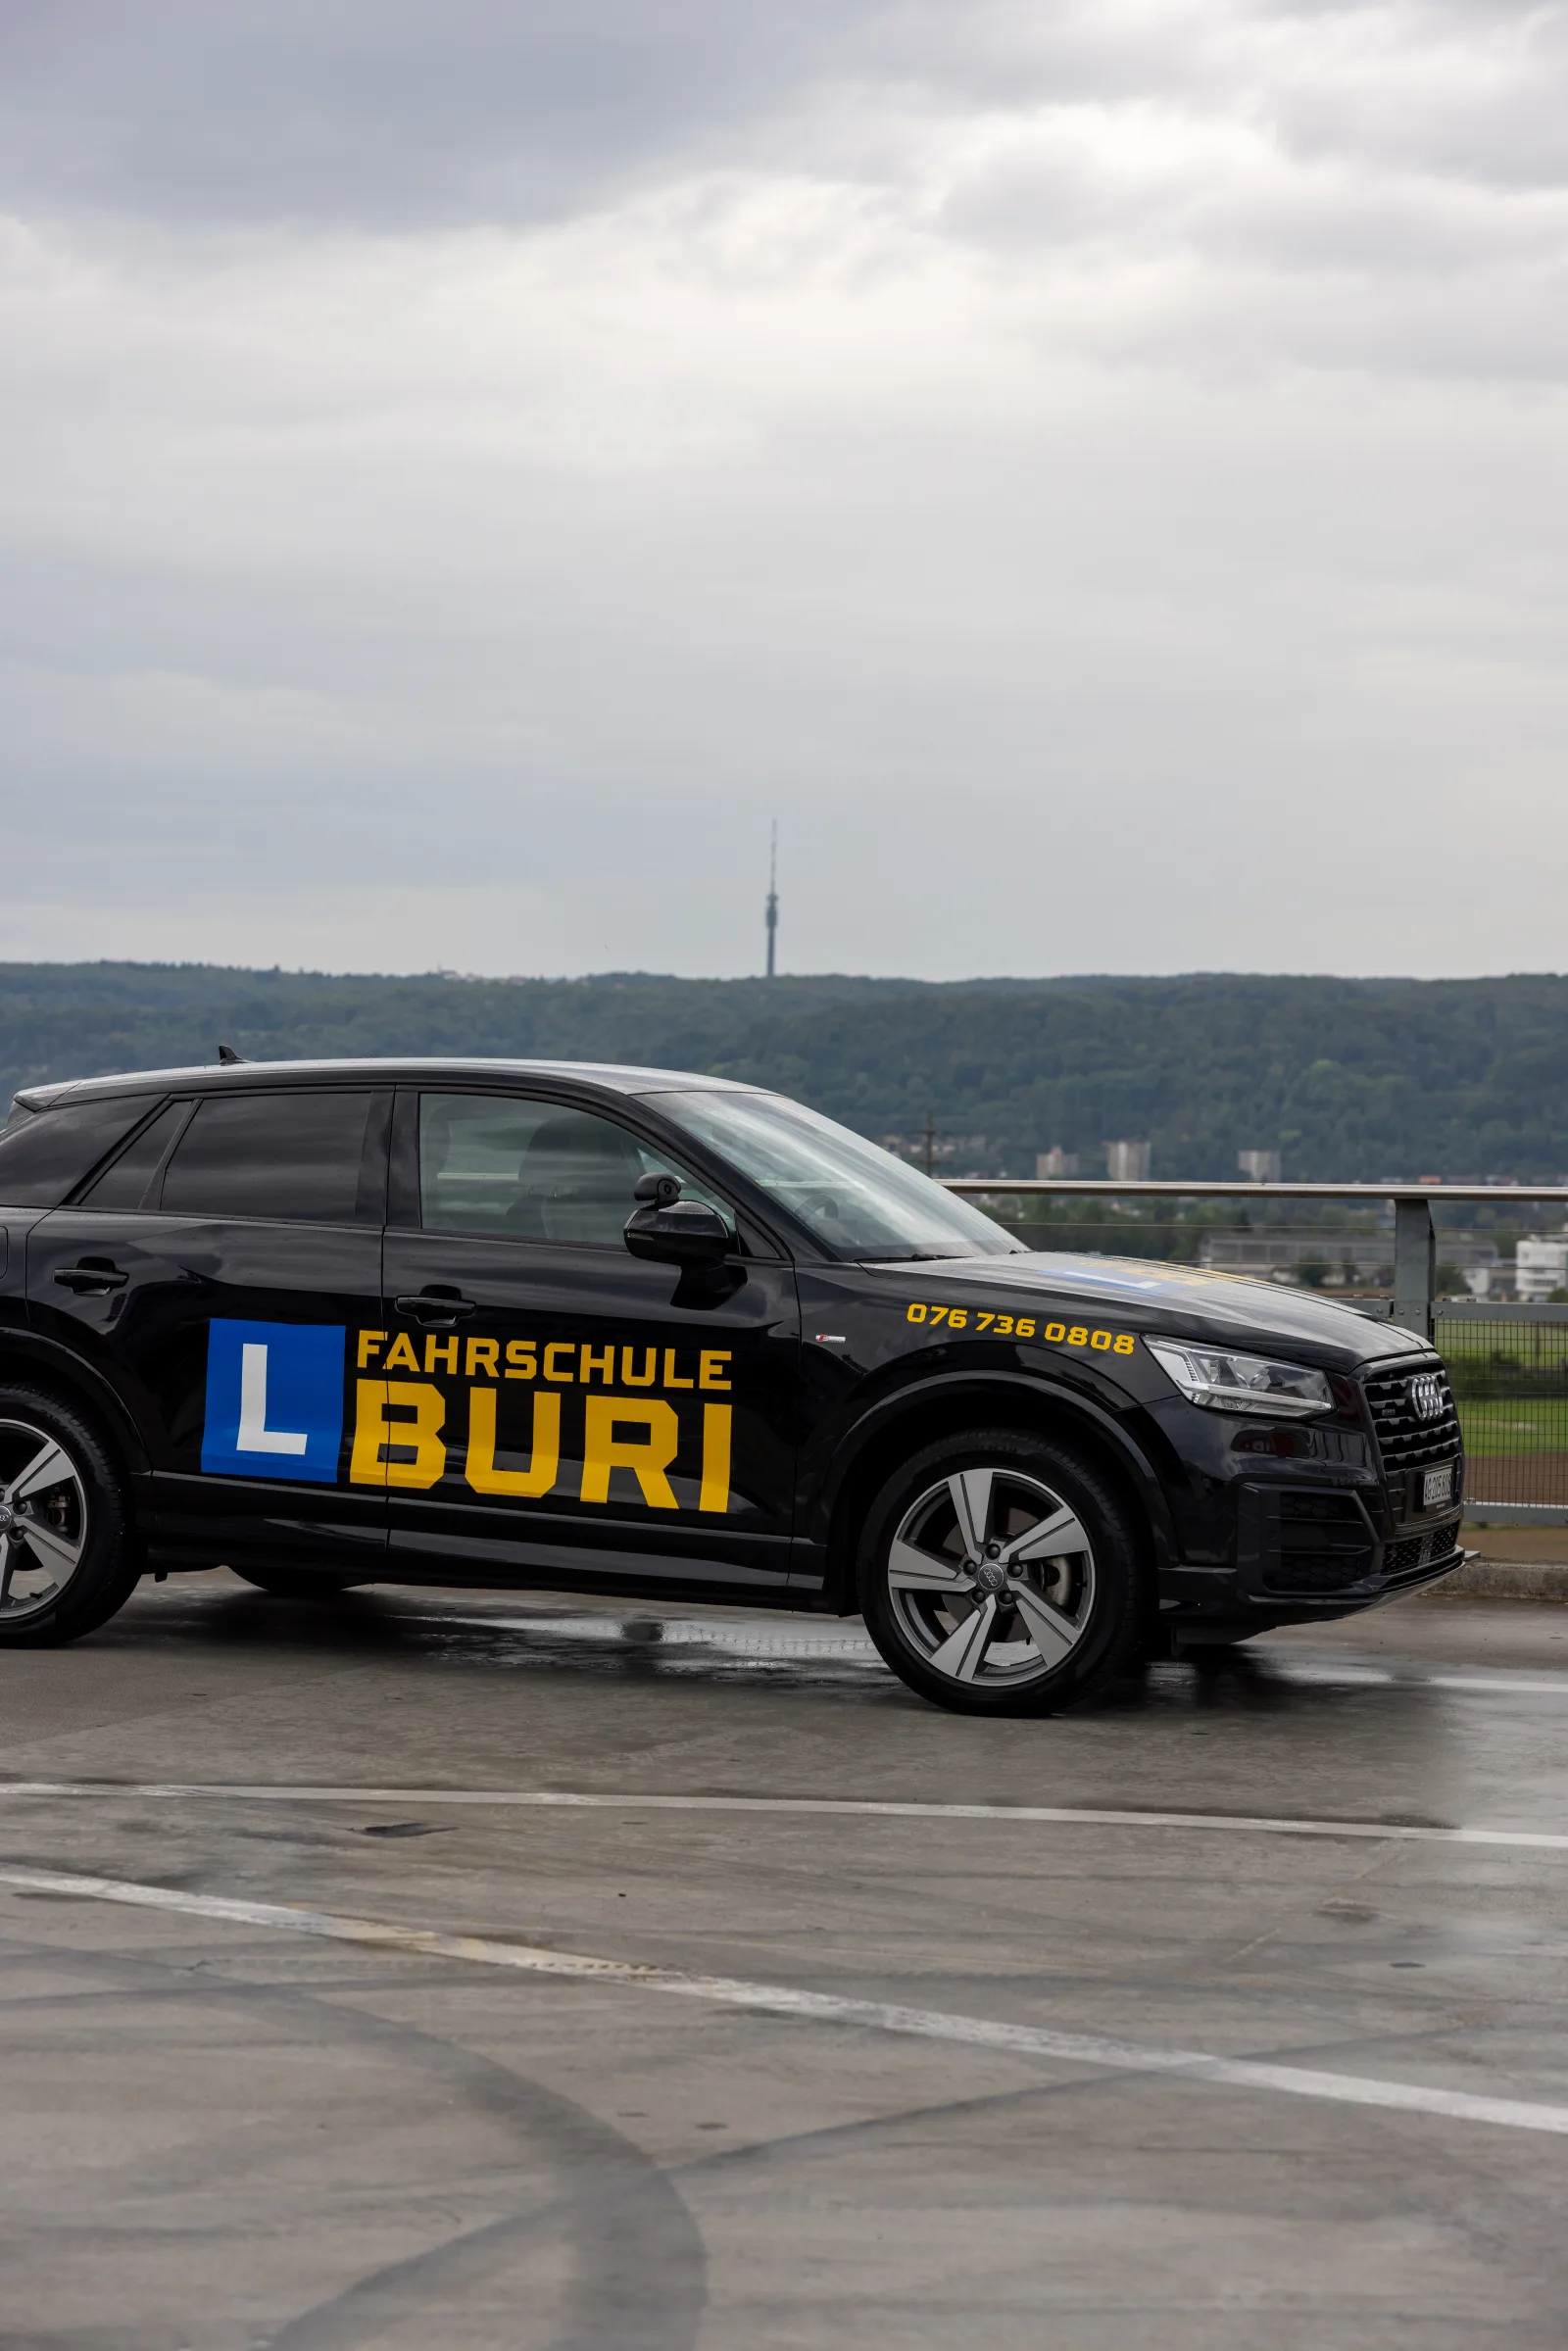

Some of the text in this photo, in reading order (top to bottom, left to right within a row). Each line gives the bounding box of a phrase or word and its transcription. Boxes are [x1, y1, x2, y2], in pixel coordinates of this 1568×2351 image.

[357, 1329, 732, 1391] FAHRSCHULE
[906, 1303, 1135, 1355] 076 736 0808
[236, 1343, 308, 1455] L
[349, 1378, 733, 1514] BURI
